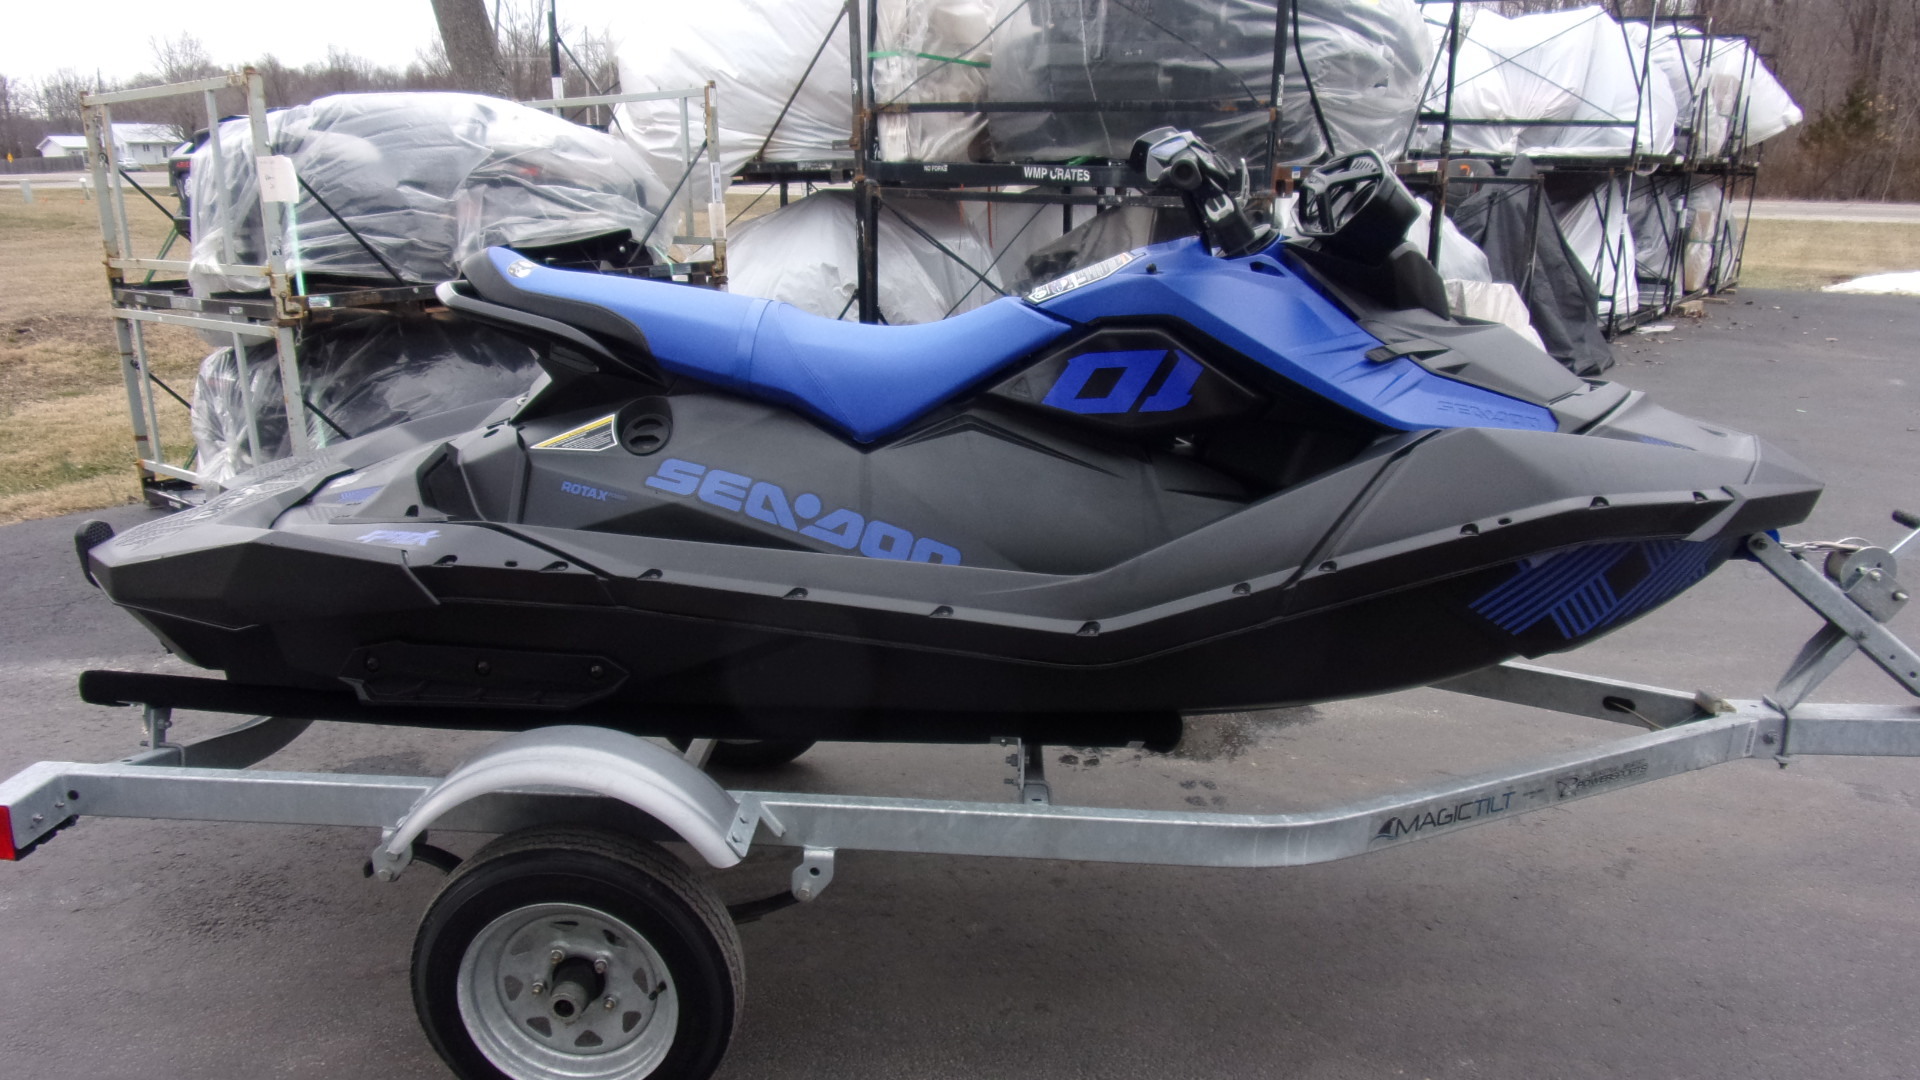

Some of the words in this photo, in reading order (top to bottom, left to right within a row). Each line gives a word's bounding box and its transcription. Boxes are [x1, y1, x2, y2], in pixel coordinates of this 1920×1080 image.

[1024, 166, 1047, 179] WMP
[1050, 167, 1090, 181] CRATES
[561, 481, 608, 501] ROTAX
